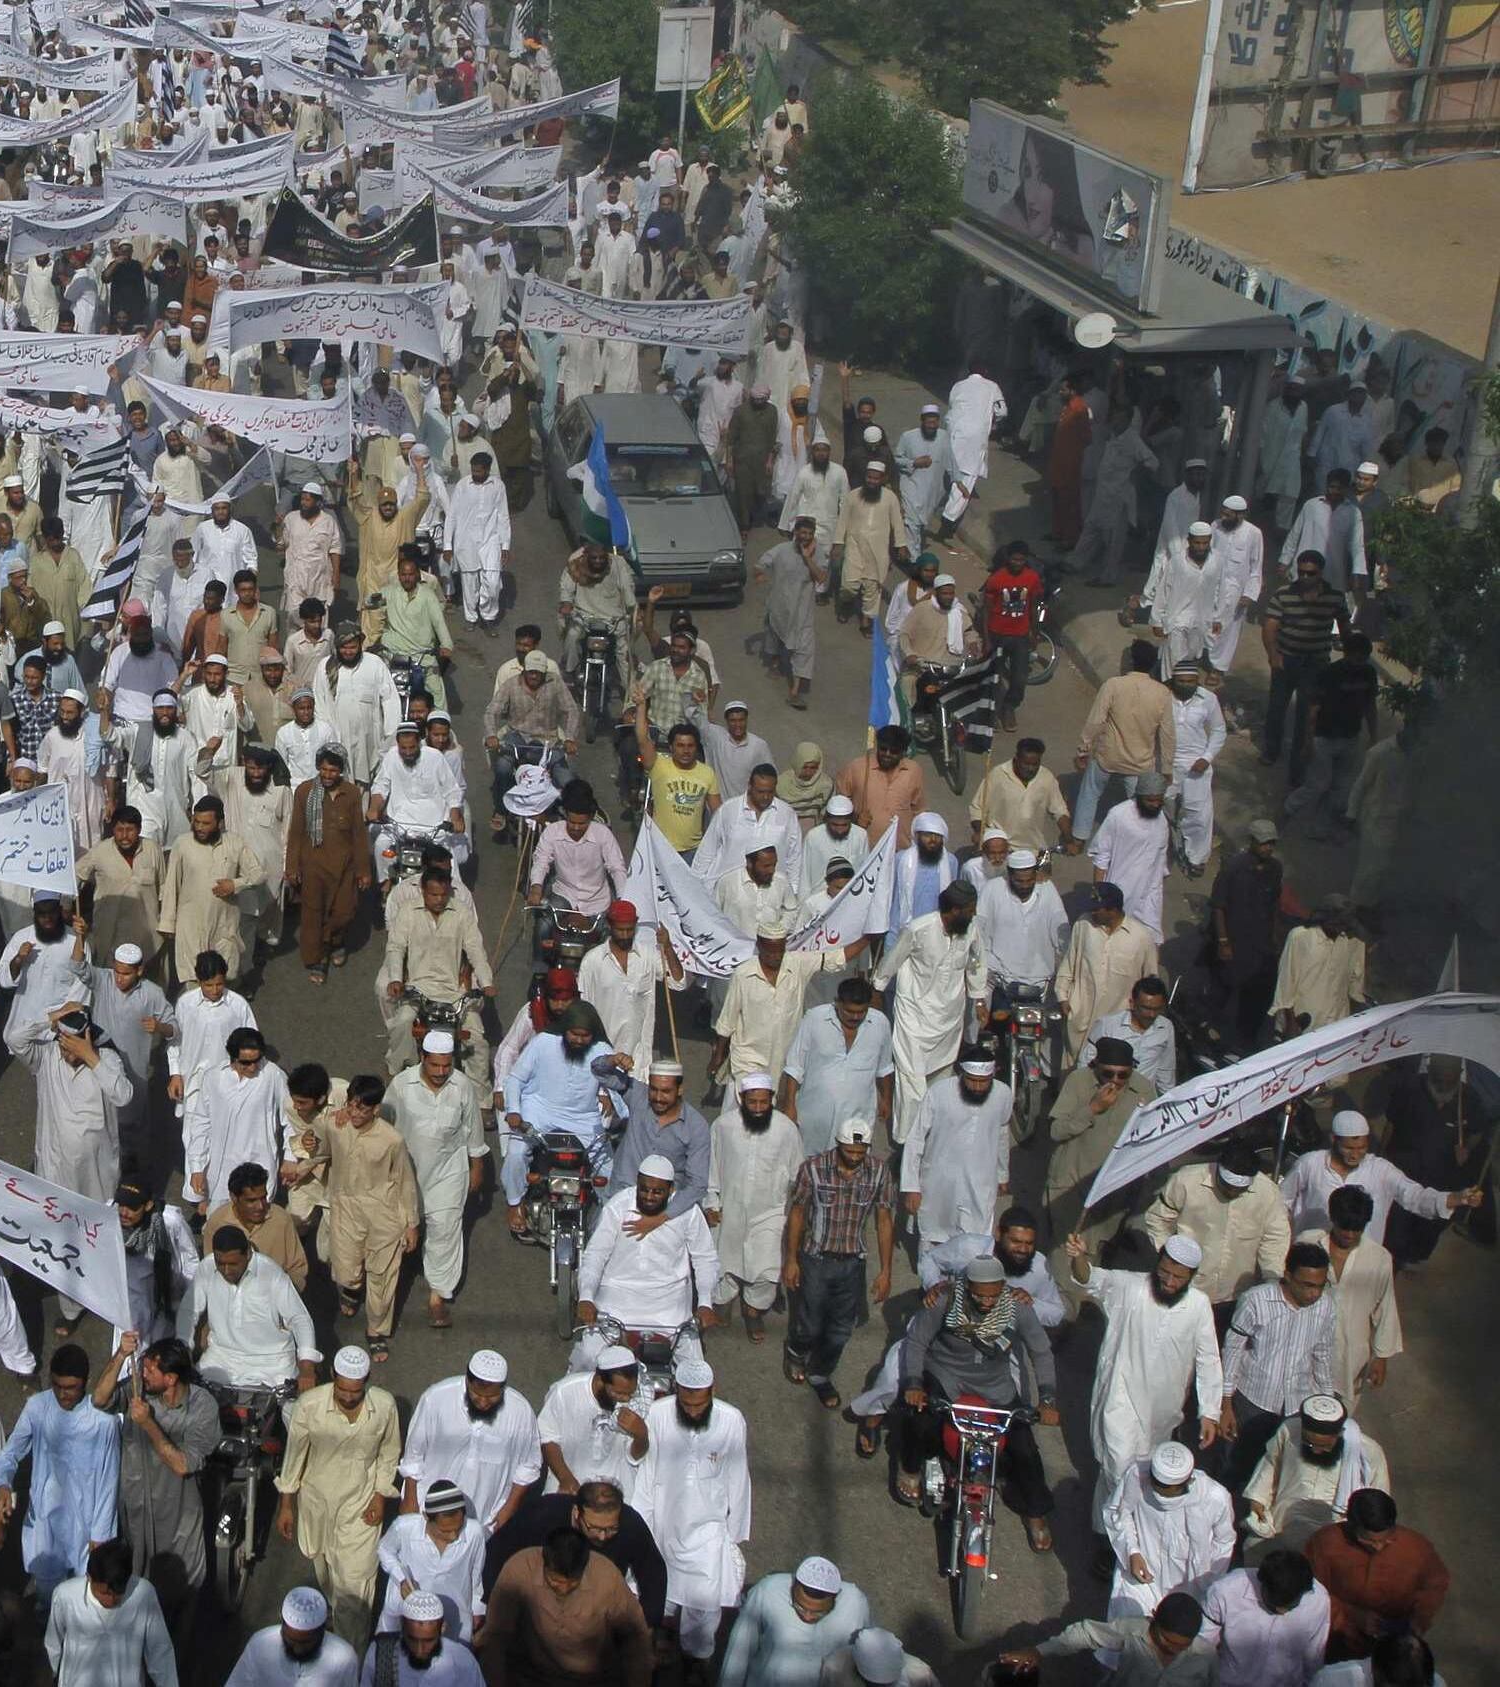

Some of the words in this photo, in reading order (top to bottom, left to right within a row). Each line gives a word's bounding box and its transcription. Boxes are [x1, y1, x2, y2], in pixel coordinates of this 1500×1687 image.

[376, 318, 396, 340] عالمی
[17, 365, 40, 385] عالمی
[1, 835, 30, 874] ختم
[27, 847, 68, 874] تعلقات
[1360, 1026, 1411, 1065] عالمی
[1288, 1029, 1369, 1094] مجلس
[5, 1177, 39, 1204] کے
[83, 1219, 103, 1248] کیا
